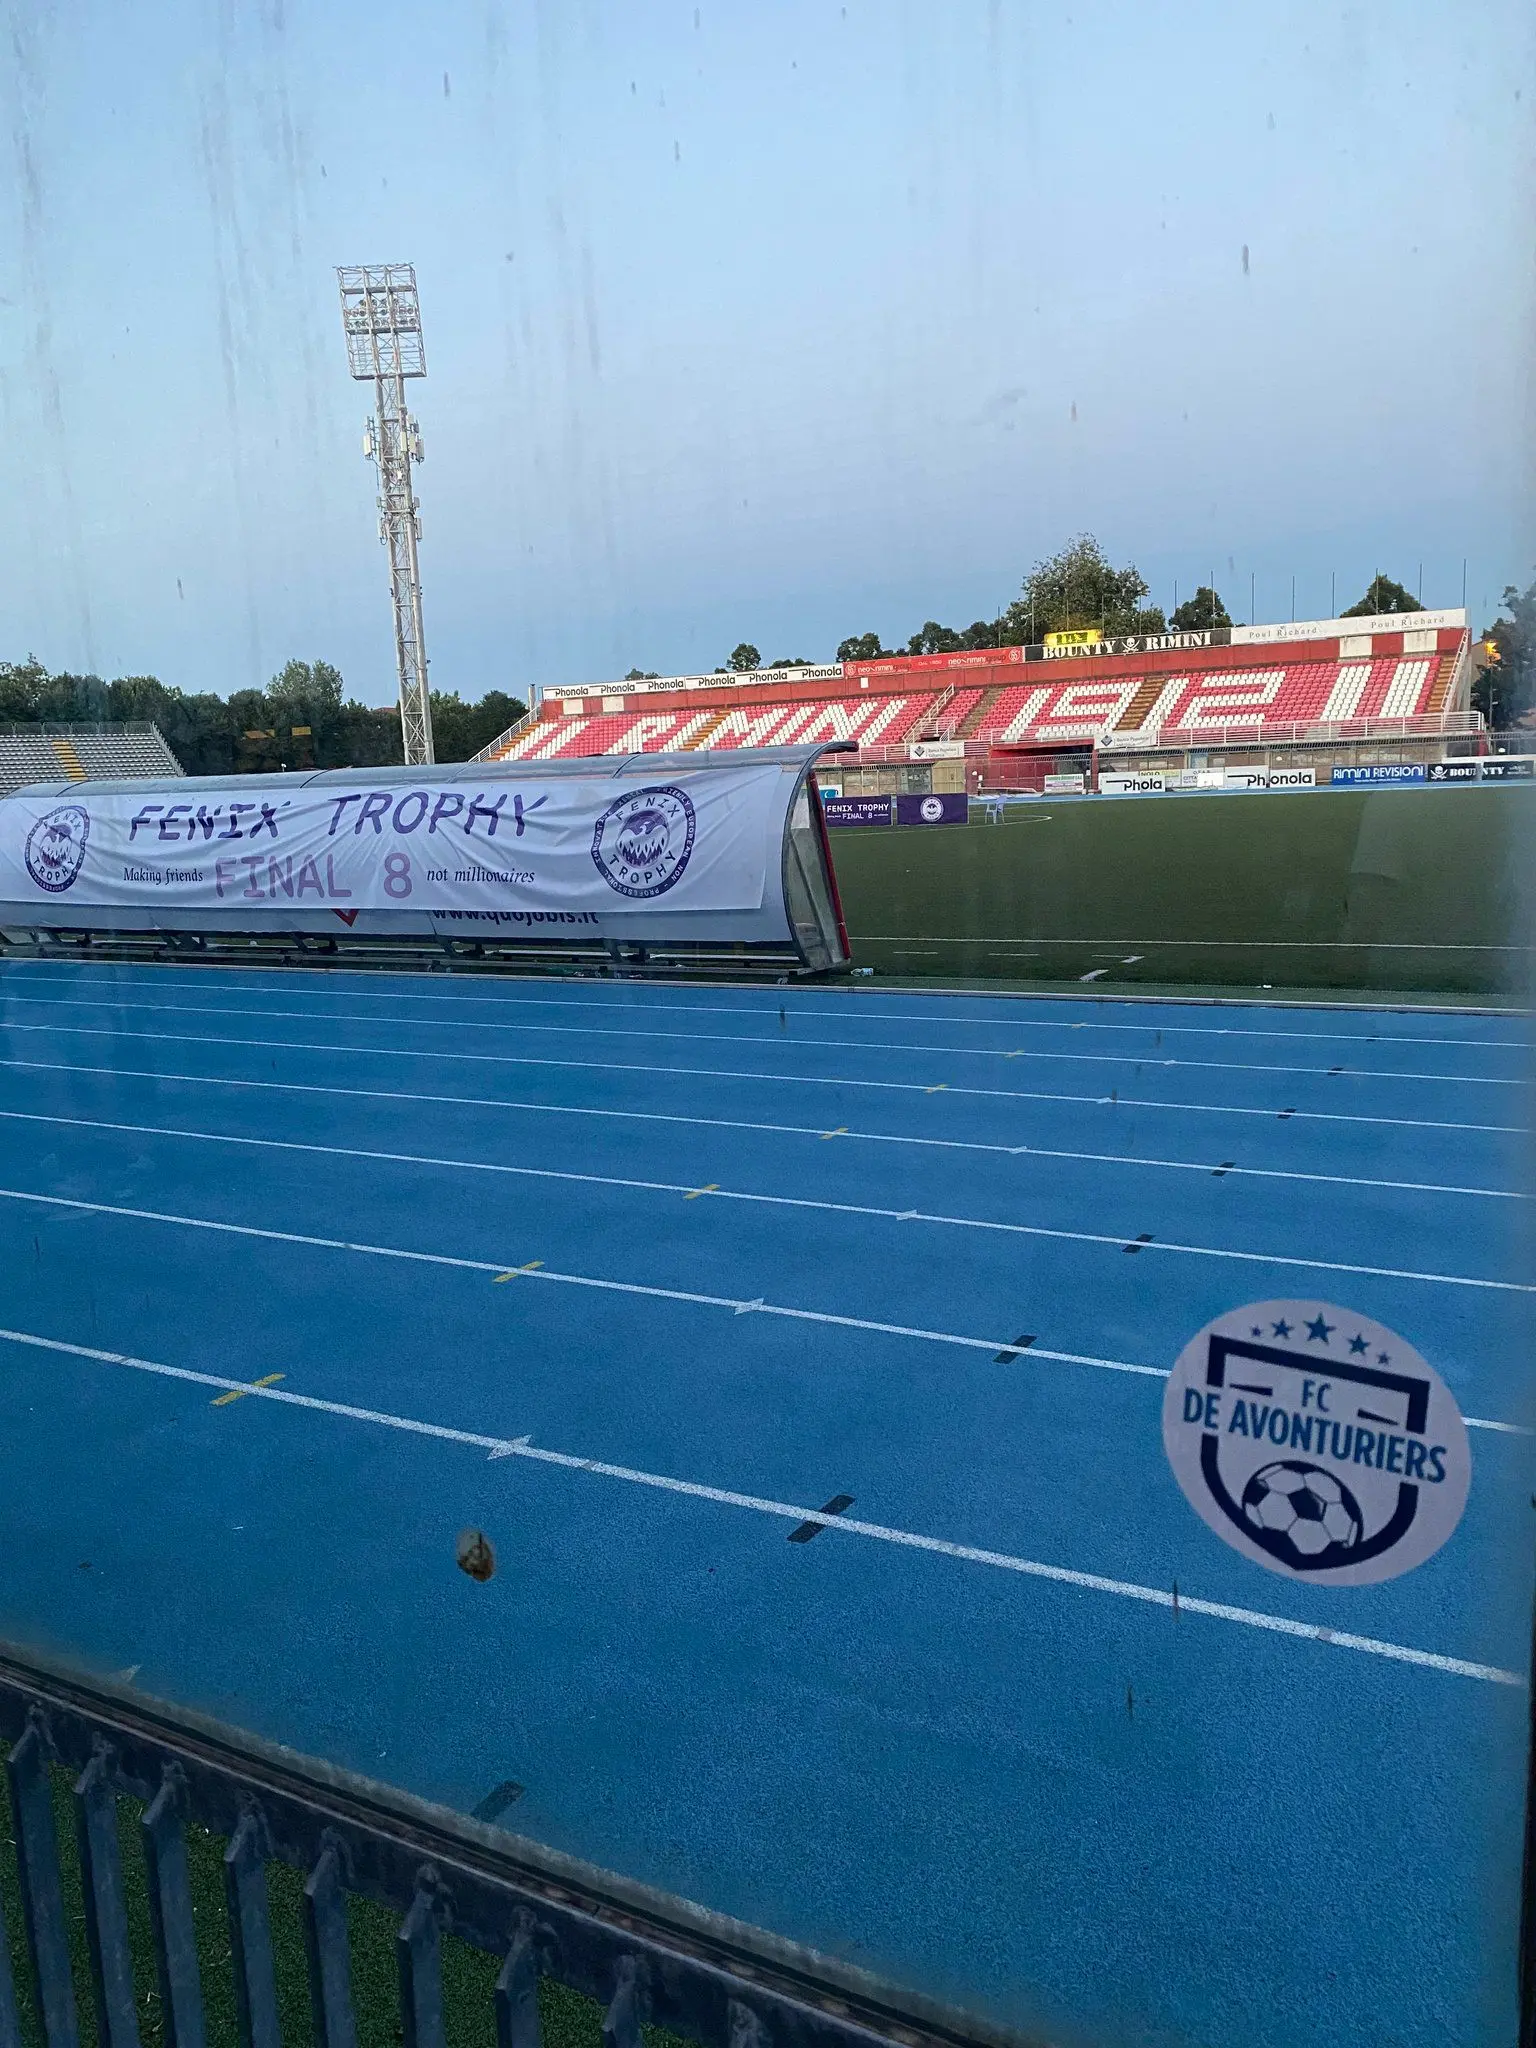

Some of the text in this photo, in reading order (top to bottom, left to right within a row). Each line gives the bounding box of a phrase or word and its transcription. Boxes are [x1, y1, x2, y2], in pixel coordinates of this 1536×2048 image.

[1401, 616, 1445, 627] Richard
[1277, 626, 1318, 637] Richard
[1042, 631, 1212, 660] BOUNTY RIMINI
[686, 675, 735, 686] Phonola
[736, 671, 787, 683] Phonola
[788, 666, 842, 679] Phonola
[544, 686, 588, 697] Phonola
[589, 683, 635, 694] Phonola
[636, 679, 684, 690] Phonola
[1001, 671, 1286, 742] 1912
[1333, 765, 1424, 779] RIMINI REVISIONI
[1106, 778, 1162, 791] Phola
[129, 791, 549, 841] FENIX TROPHY
[615, 796, 680, 821] FENIX
[826, 803, 890, 812] FENIX TROPHY
[43, 813, 82, 831] FENIX
[686, 809, 696, 858] EUROPEAN
[33, 856, 74, 882] TROPHY
[123, 867, 204, 885] Making friends
[215, 852, 413, 899] FINAL 8
[426, 866, 535, 884] not millionaires
[609, 850, 676, 884] TROPHY
[1301, 1379, 1333, 1413] FC
[1183, 1387, 1447, 1483] DE AVONTURIERS
